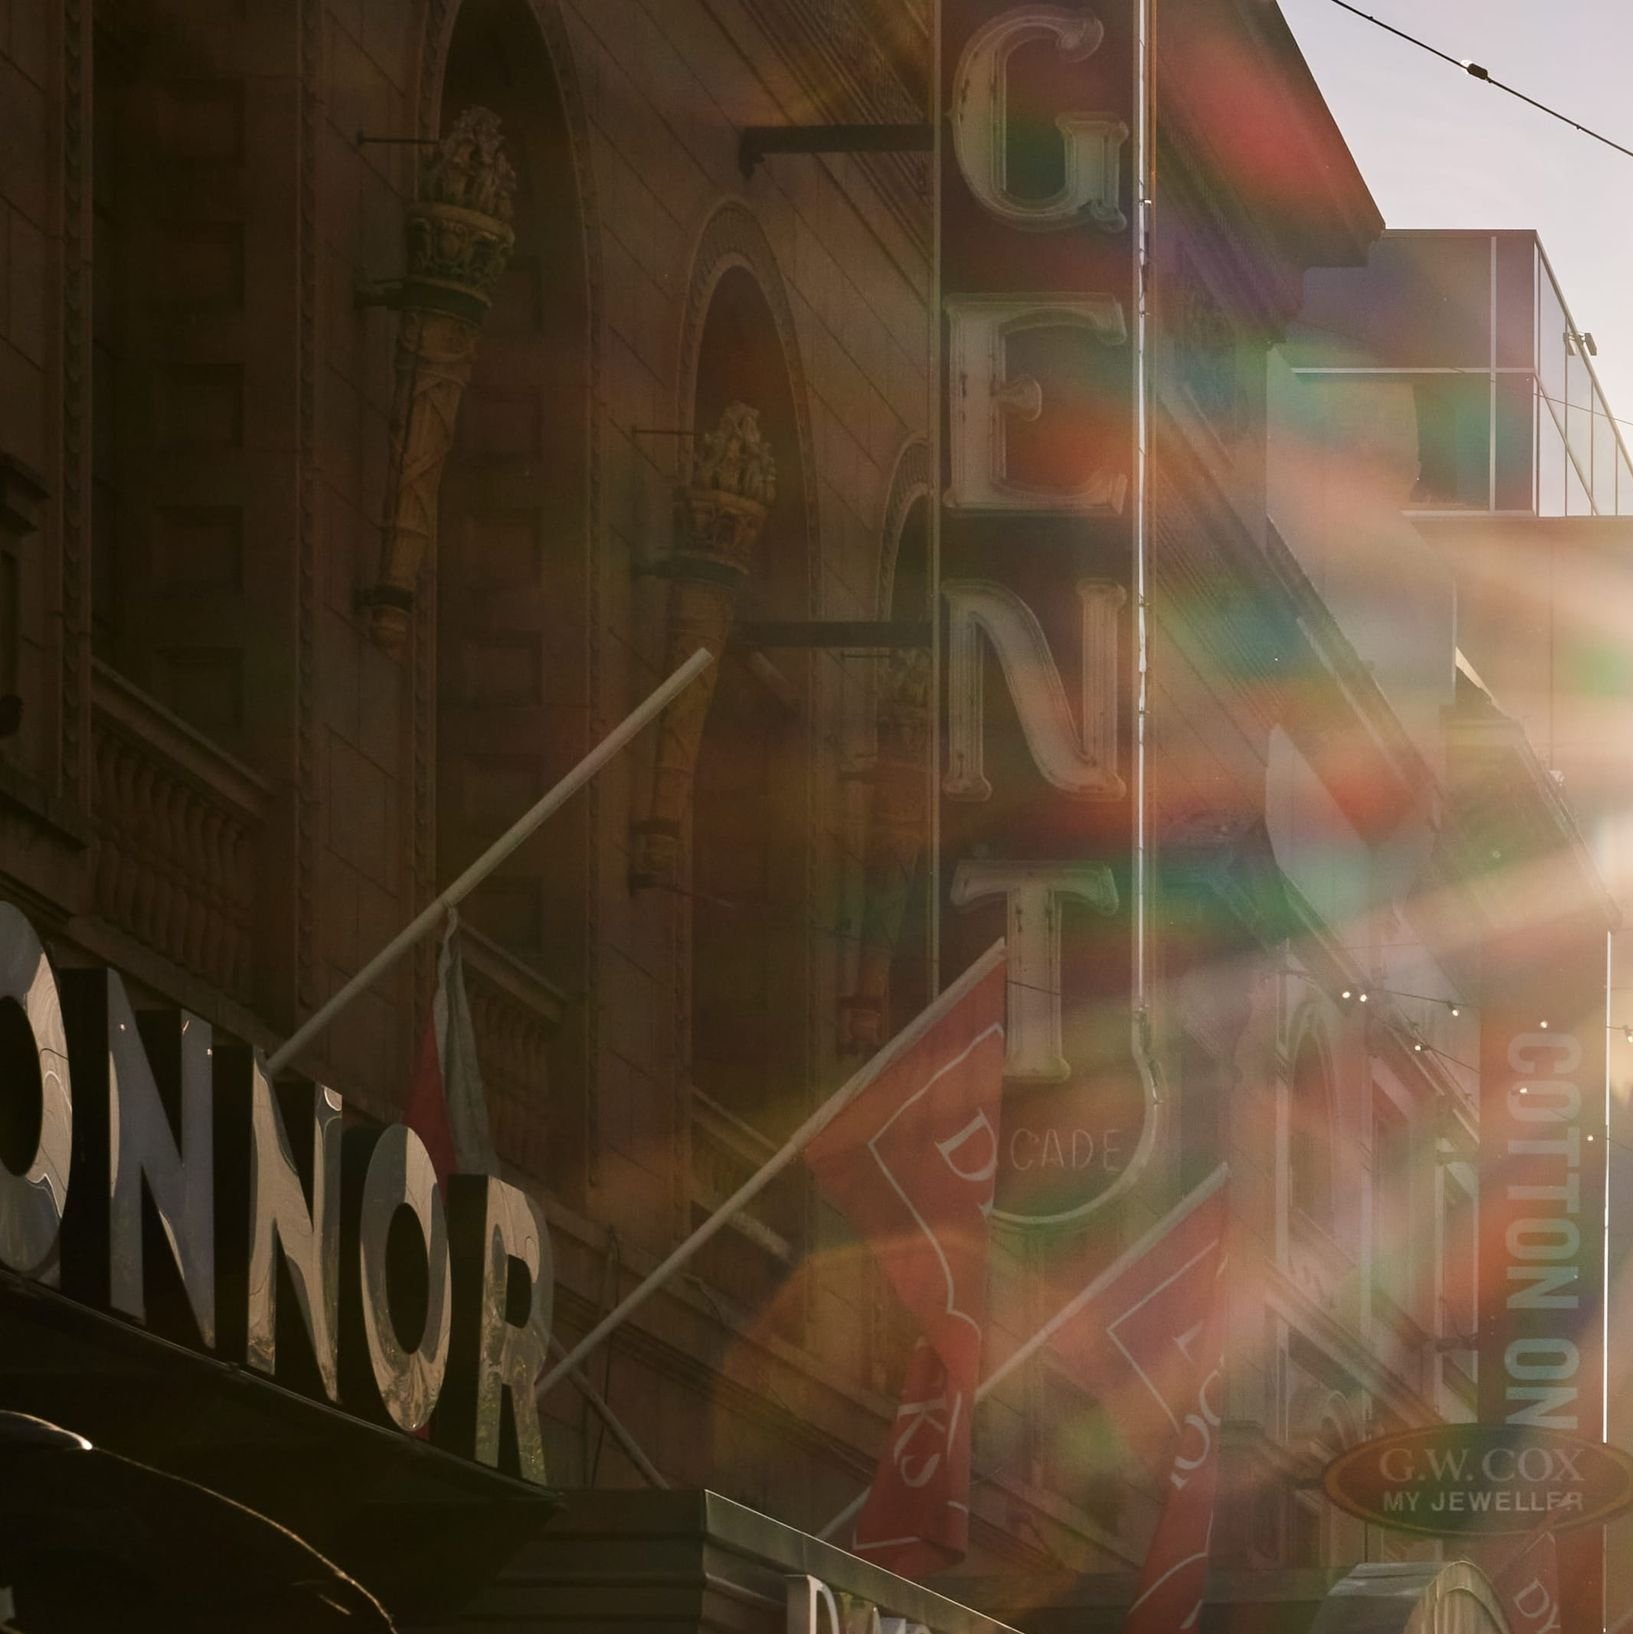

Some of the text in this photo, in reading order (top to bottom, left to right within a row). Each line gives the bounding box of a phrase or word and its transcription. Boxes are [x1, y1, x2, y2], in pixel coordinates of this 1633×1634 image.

[1009, 1127, 1122, 1171] CADE
[1503, 1032, 1582, 1430] COTTON ON
[1378, 1448, 1585, 1483] G.W. COX
[1383, 1491, 1584, 1512] MY JEWELLER
